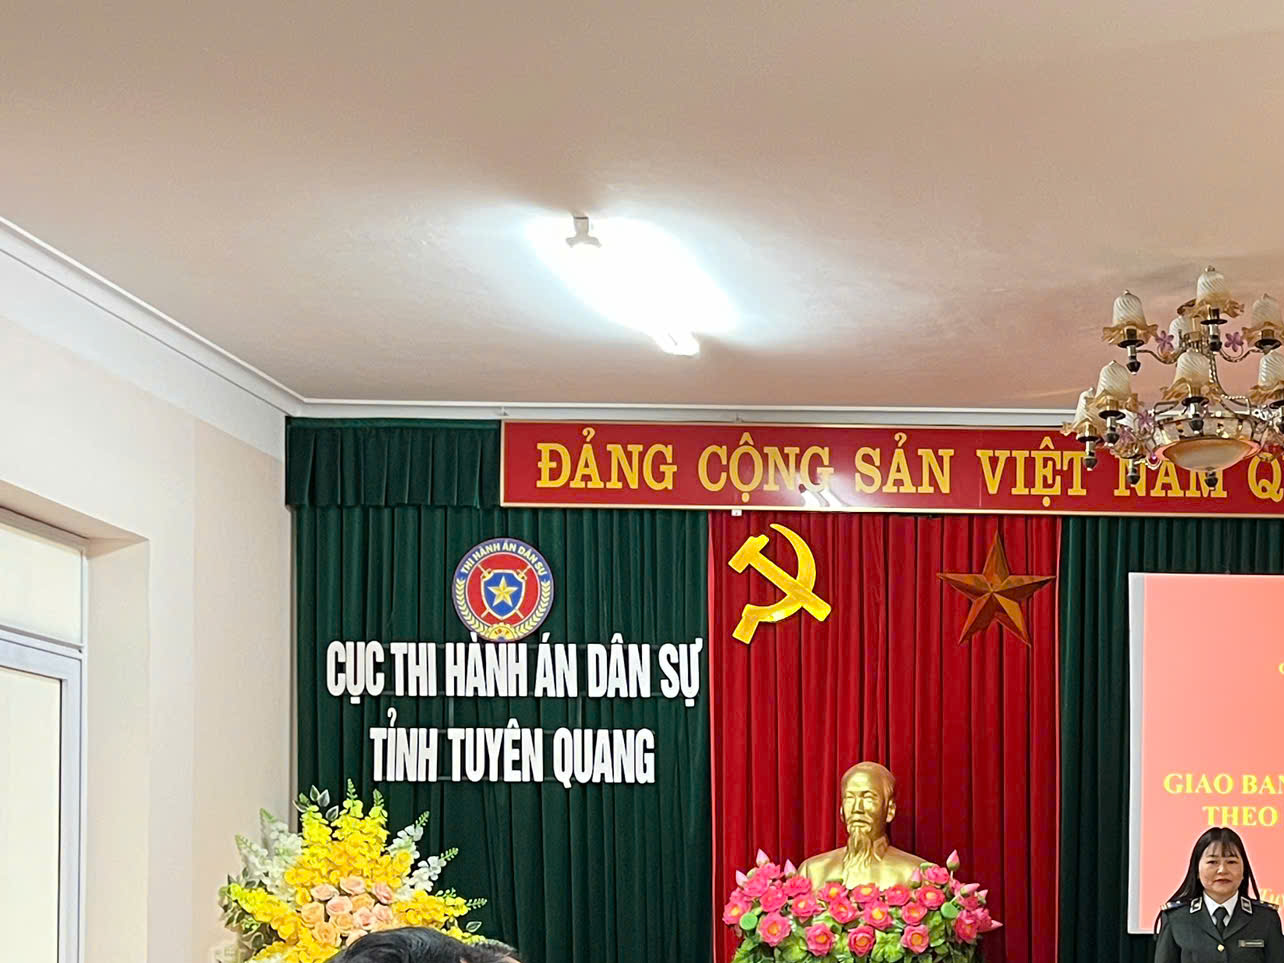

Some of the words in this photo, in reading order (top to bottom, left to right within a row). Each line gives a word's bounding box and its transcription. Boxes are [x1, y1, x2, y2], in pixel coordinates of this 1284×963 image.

[536, 427, 677, 491] ĐẢNG
[697, 431, 836, 503] CỘNG
[853, 431, 954, 495] SẢN
[976, 436, 1087, 507] VIỆT
[326, 640, 385, 704] CỤC
[390, 641, 437, 697] THI
[445, 631, 528, 697] HÀNH
[534, 632, 578, 697] ÁN
[587, 633, 651, 698] DÂN
[658, 637, 703, 707] SỰ
[370, 707, 438, 782] TỈNH
[447, 718, 544, 783] TUYÊN
[552, 728, 656, 789] QUANG
[1163, 773, 1234, 795] GIAO
[1202, 805, 1279, 827] THEO
